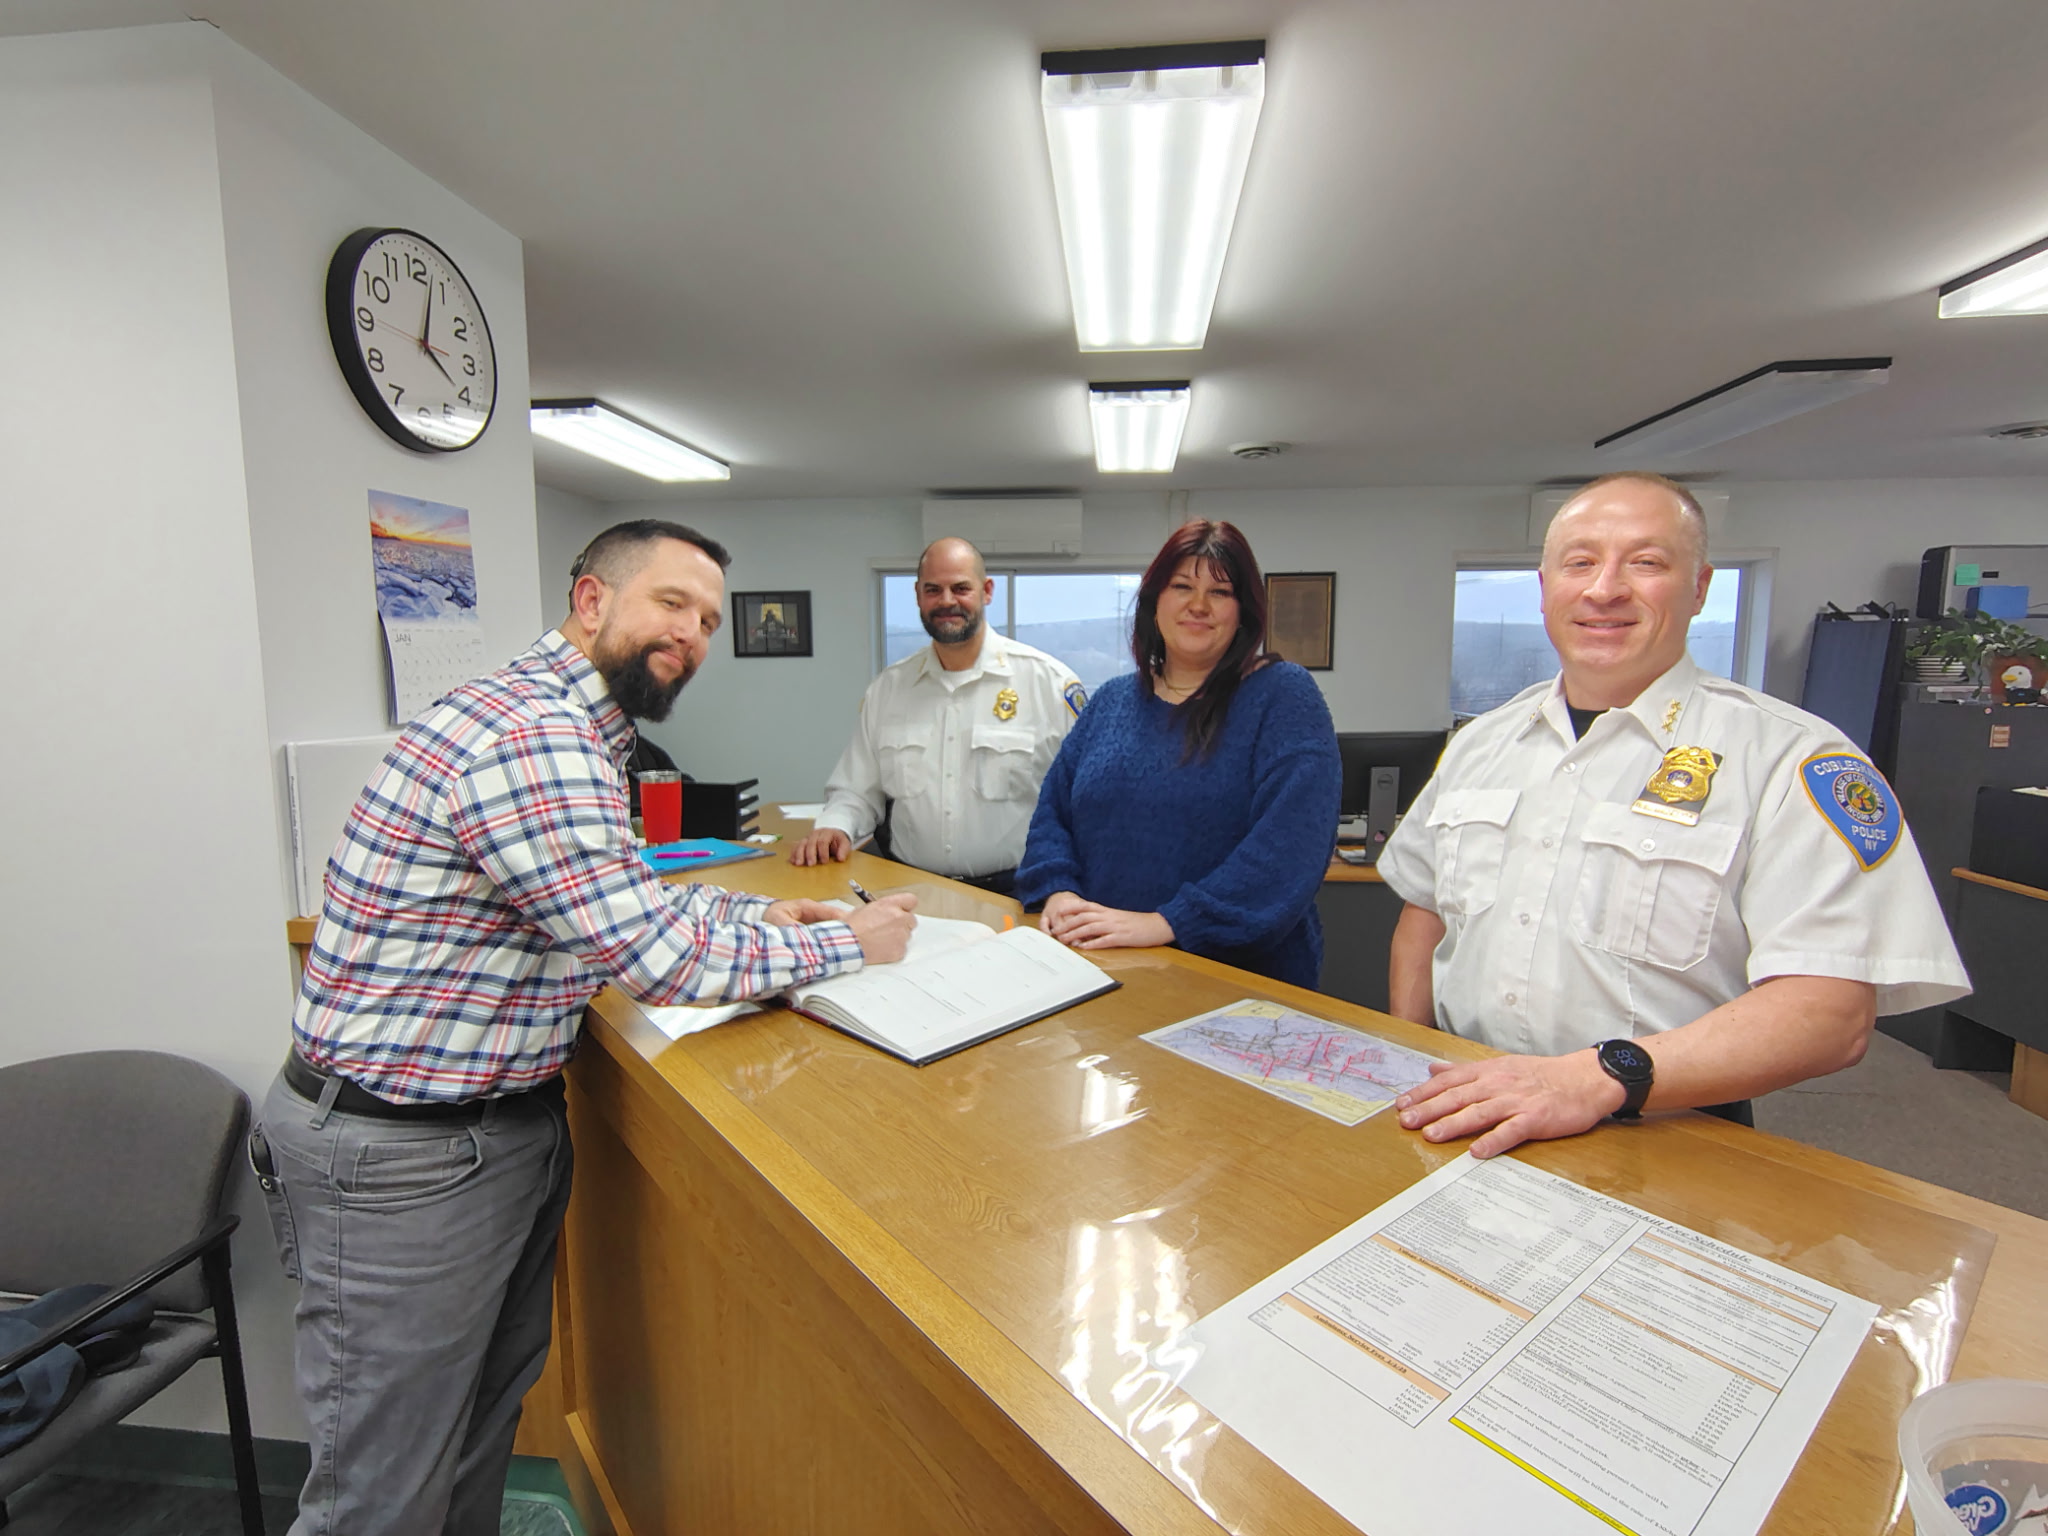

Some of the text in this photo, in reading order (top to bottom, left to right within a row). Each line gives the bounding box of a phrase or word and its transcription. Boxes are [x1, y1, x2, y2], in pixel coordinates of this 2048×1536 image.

[383, 251, 399, 282] 11
[404, 252, 428, 286] 12
[363, 270, 391, 304] 10
[439, 281, 445, 306] 1
[357, 306, 375, 332] 9
[453, 316, 468, 342] 2
[367, 347, 385, 373] 8
[462, 353, 476, 376] 3
[388, 382, 406, 407] 7
[457, 385, 472, 406] 4
[394, 633, 412, 643] JAN
[1851, 824, 1888, 841] POLICE
[1864, 838, 1878, 851] NY
[1549, 1177, 1590, 1196] Village
[1590, 1193, 1604, 1201] of
[1604, 1199, 1665, 1227] Cobleskill
[1665, 1224, 1692, 1238] Fee
[1691, 1235, 1754, 1264] Schedule
[1312, 1314, 1387, 1361] Ambulance Service Fees
